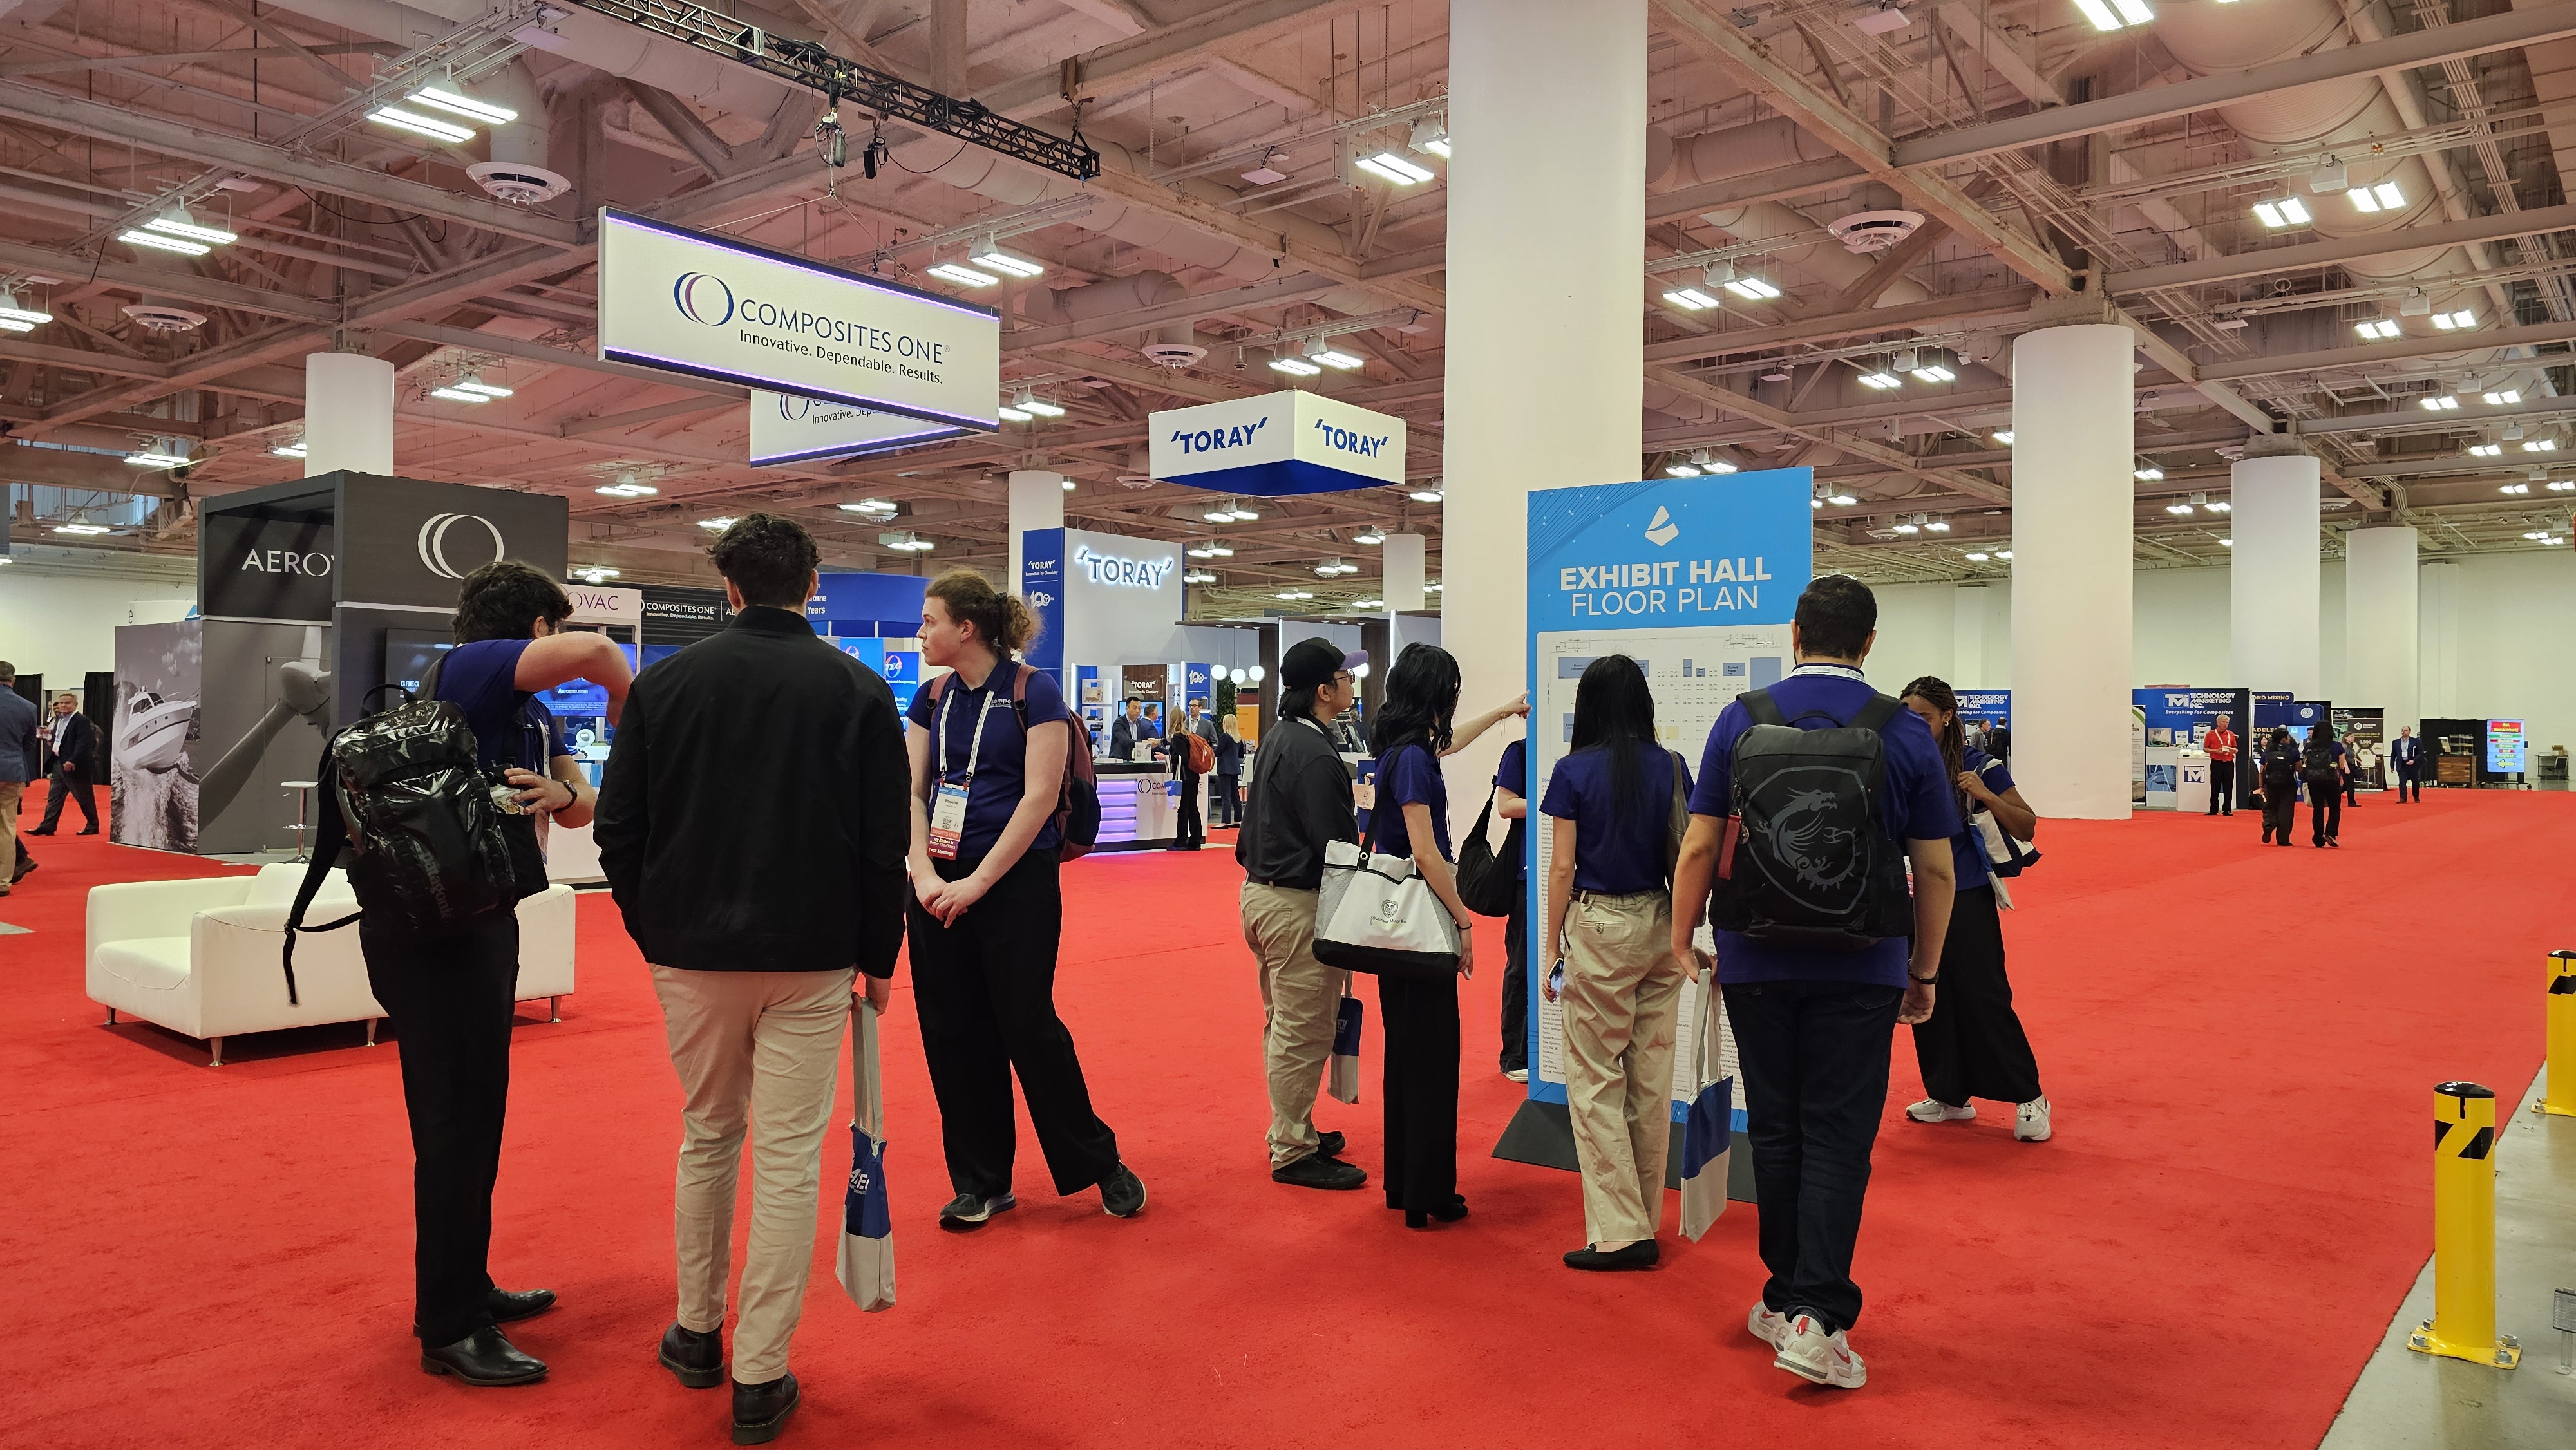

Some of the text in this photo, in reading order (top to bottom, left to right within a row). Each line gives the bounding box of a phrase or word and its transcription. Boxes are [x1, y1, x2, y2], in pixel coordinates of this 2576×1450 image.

[740, 299, 891, 353] COMPOSITES
[740, 328, 943, 384] Innovative. Dependable. Results.
[811, 408, 876, 424] Innovative. Dep
[241, 548, 334, 577] AERO
[1560, 556, 1772, 591] EXHIBIT HALL
[646, 602, 696, 614] COMPOSITES
[808, 606, 826, 614] Years
[1571, 585, 1758, 616] FLOOR PLAN
